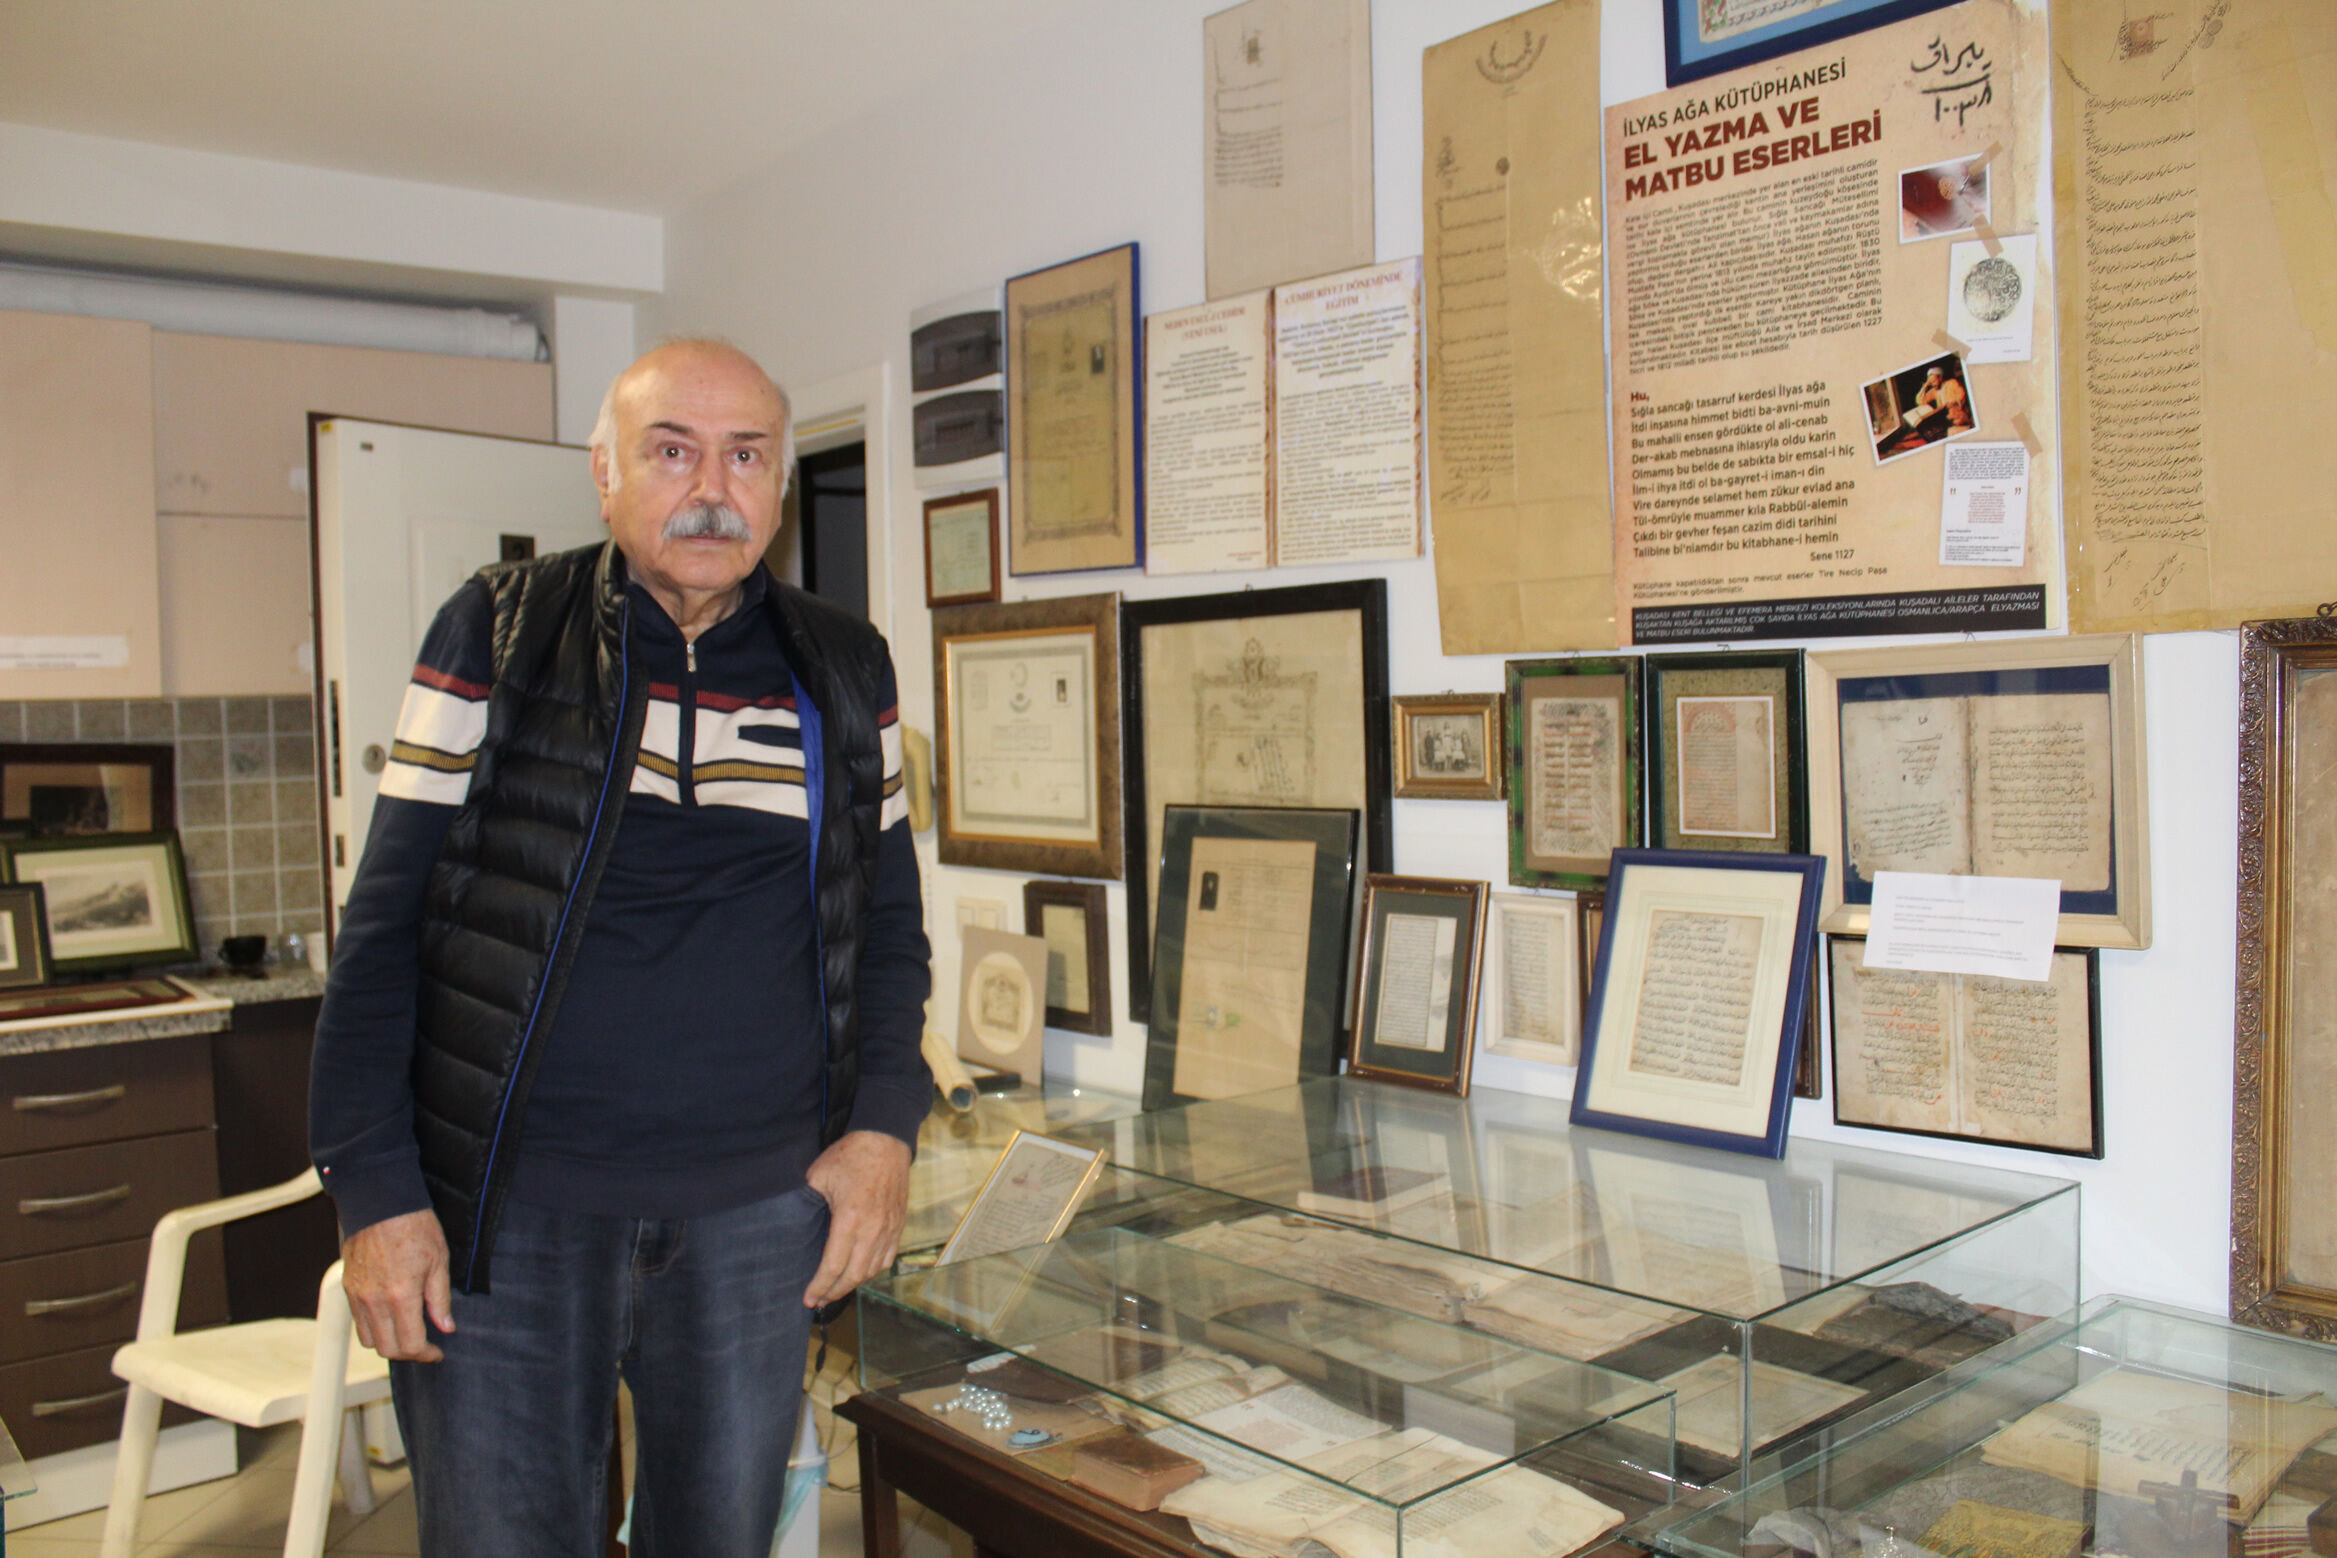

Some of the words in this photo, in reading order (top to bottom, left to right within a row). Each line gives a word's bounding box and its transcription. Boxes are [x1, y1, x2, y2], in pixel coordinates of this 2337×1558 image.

[1623, 111, 1667, 136] İLYAS
[1673, 99, 1709, 124] AĞA
[1715, 56, 1845, 112] KÜTÜPHANESİ
[1624, 142, 1657, 169] EL
[1664, 111, 1769, 157] YAZMA
[1777, 96, 1819, 128] VE
[1625, 155, 1724, 201] MATBU
[1733, 109, 1881, 175] ESERLERİ
[1791, 177, 1801, 185] en
[1802, 172, 1819, 182] eski
[1820, 166, 1844, 178] tarihli
[1846, 158, 1877, 172] camidir
[1789, 188, 1834, 206] kuzeydoğu
[1795, 230, 1820, 242] Hasan
[1851, 217, 1880, 230] torunu
[1794, 250, 1815, 262] tayin
[1861, 247, 1880, 258] İlyas
[1808, 282, 1853, 298] dikdörtgen
[1847, 286, 1882, 299] Caminin
[1856, 306, 1882, 317] olarak
[1869, 297, 1882, 305] Bu
[1798, 327, 1818, 337] tarih
[1863, 316, 1882, 325] 1227
[1630, 391, 1649, 401] Hu,
[1630, 406, 1654, 418] Sığla
[1657, 399, 1693, 414] sancağı
[1696, 392, 1735, 408] tasarruf
[1738, 387, 1775, 401] kerdesi
[1778, 385, 1802, 397] İlyas
[1806, 381, 1825, 393] ağa
[1691, 410, 1728, 424] himmet
[1631, 438, 1643, 448] Bu
[1646, 432, 1681, 446] mahalli
[1684, 431, 1713, 441] ensen
[1716, 424, 1762, 439] gördükte
[1765, 419, 1775, 431] ol
[1778, 413, 1827, 429] ali-cenab
[1736, 437, 1778, 451] ihlasıyla
[1782, 433, 1805, 445] oldu
[1808, 430, 1835, 442] karin
[1631, 467, 1674, 479] Olmamış
[1676, 464, 1689, 474] bu
[1691, 461, 1719, 473] belde
[1722, 459, 1734, 469] de
[1738, 455, 1775, 467] sabıkta
[1778, 452, 1792, 462] bir
[1795, 446, 1835, 460] emsal-i
[1838, 444, 1854, 456] hiç
[1657, 483, 1676, 493] ihya
[1679, 479, 1695, 490] itdi
[1698, 477, 1707, 488] ol
[1710, 471, 1767, 487] ba-gayret-i
[1807, 465, 1824, 476] din
[1633, 500, 1651, 510] Vire
[1654, 495, 1699, 508] dareynde
[1702, 490, 1741, 503] selamet
[1745, 489, 1767, 499] hem
[1770, 485, 1799, 496] zükur
[1802, 480, 1831, 493] evlad
[1835, 480, 1854, 490] ana
[1693, 508, 1744, 520] muammer
[1747, 504, 1765, 515] kıla
[1768, 496, 1847, 513] Rabbül-alemin
[1633, 530, 1656, 543] Çıkdı
[1659, 529, 1672, 539] bir
[1675, 527, 1709, 540] gevher
[1712, 525, 1738, 535] feşan
[1742, 521, 1772, 532] cazim
[1775, 517, 1795, 529] didi
[1798, 514, 1836, 527] tarihini
[1633, 546, 1670, 557] Talibine
[1726, 539, 1739, 550] bu
[1742, 534, 1801, 548] kitabhane-i
[1805, 531, 1838, 543] hemin
[1810, 552, 1832, 561] Sene
[1835, 549, 1854, 558] 1127
[1838, 567, 1863, 577] Necip
[1982, 591, 2040, 602] TARAFINDAN
[1990, 601, 2040, 611] ELYAZMASI
